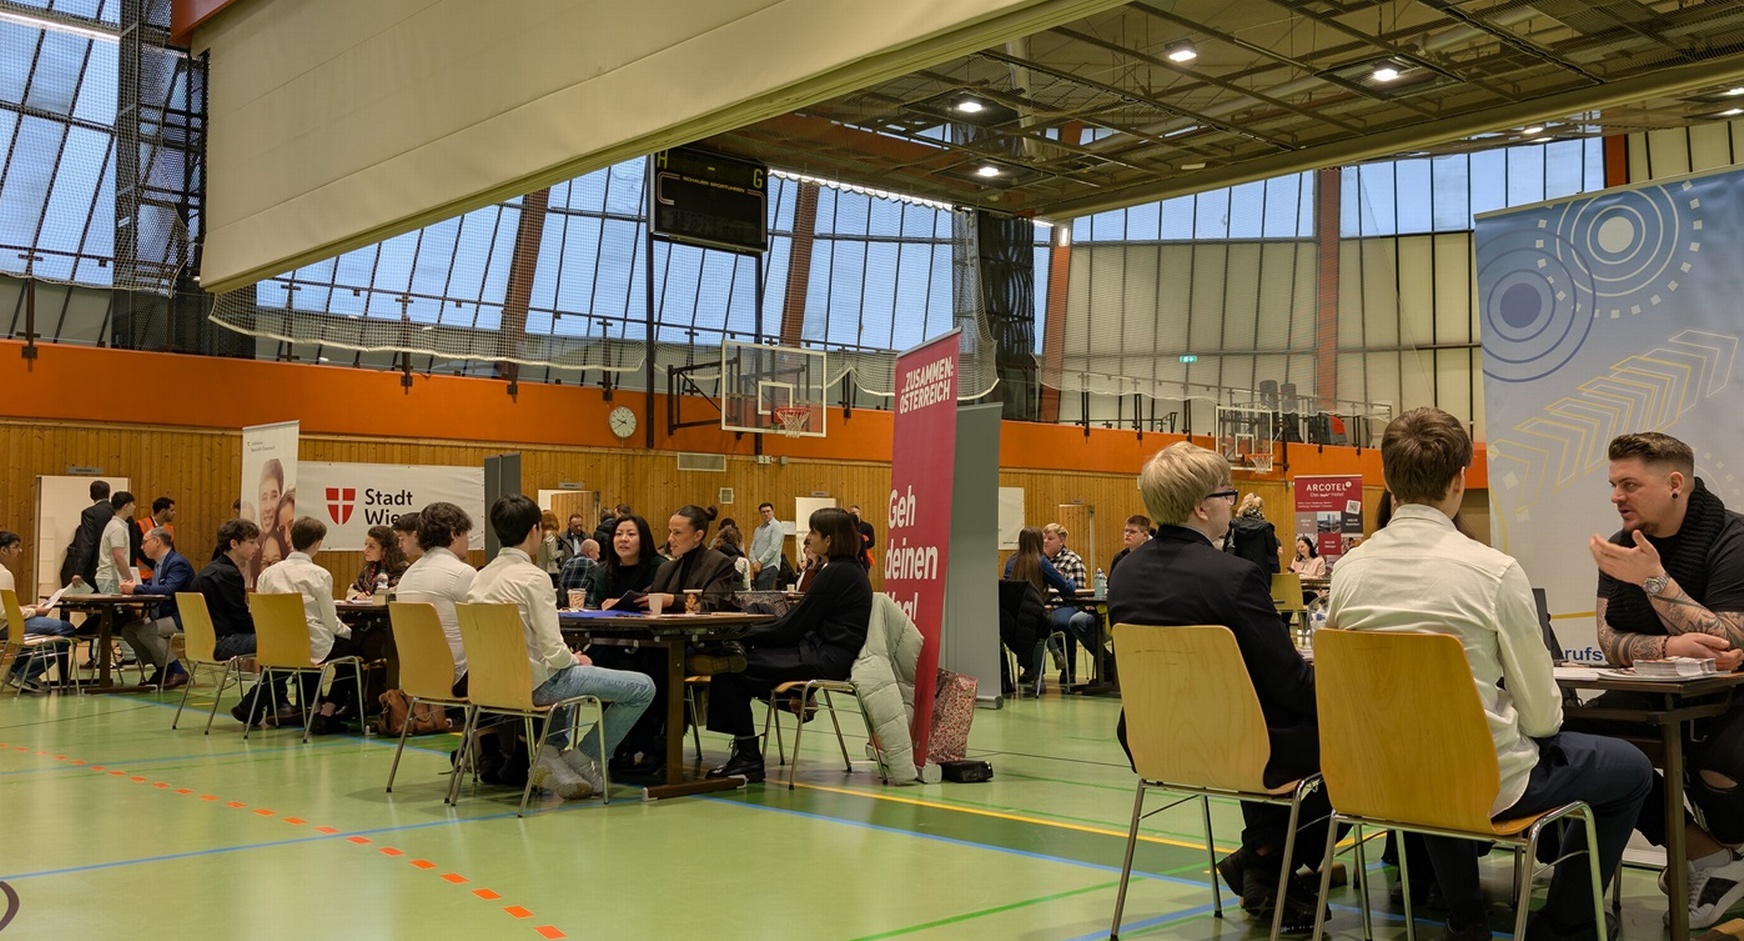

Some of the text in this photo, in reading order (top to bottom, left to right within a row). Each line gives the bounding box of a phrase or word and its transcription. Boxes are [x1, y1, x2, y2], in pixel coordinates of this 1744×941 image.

[752, 168, 764, 189] G
[1306, 482, 1348, 492] ARCOTEL
[364, 488, 413, 506] Stadt
[888, 484, 916, 529] Geh
[364, 508, 400, 526] Wie
[884, 537, 939, 580] deinen
[1564, 646, 1604, 662] rufs
